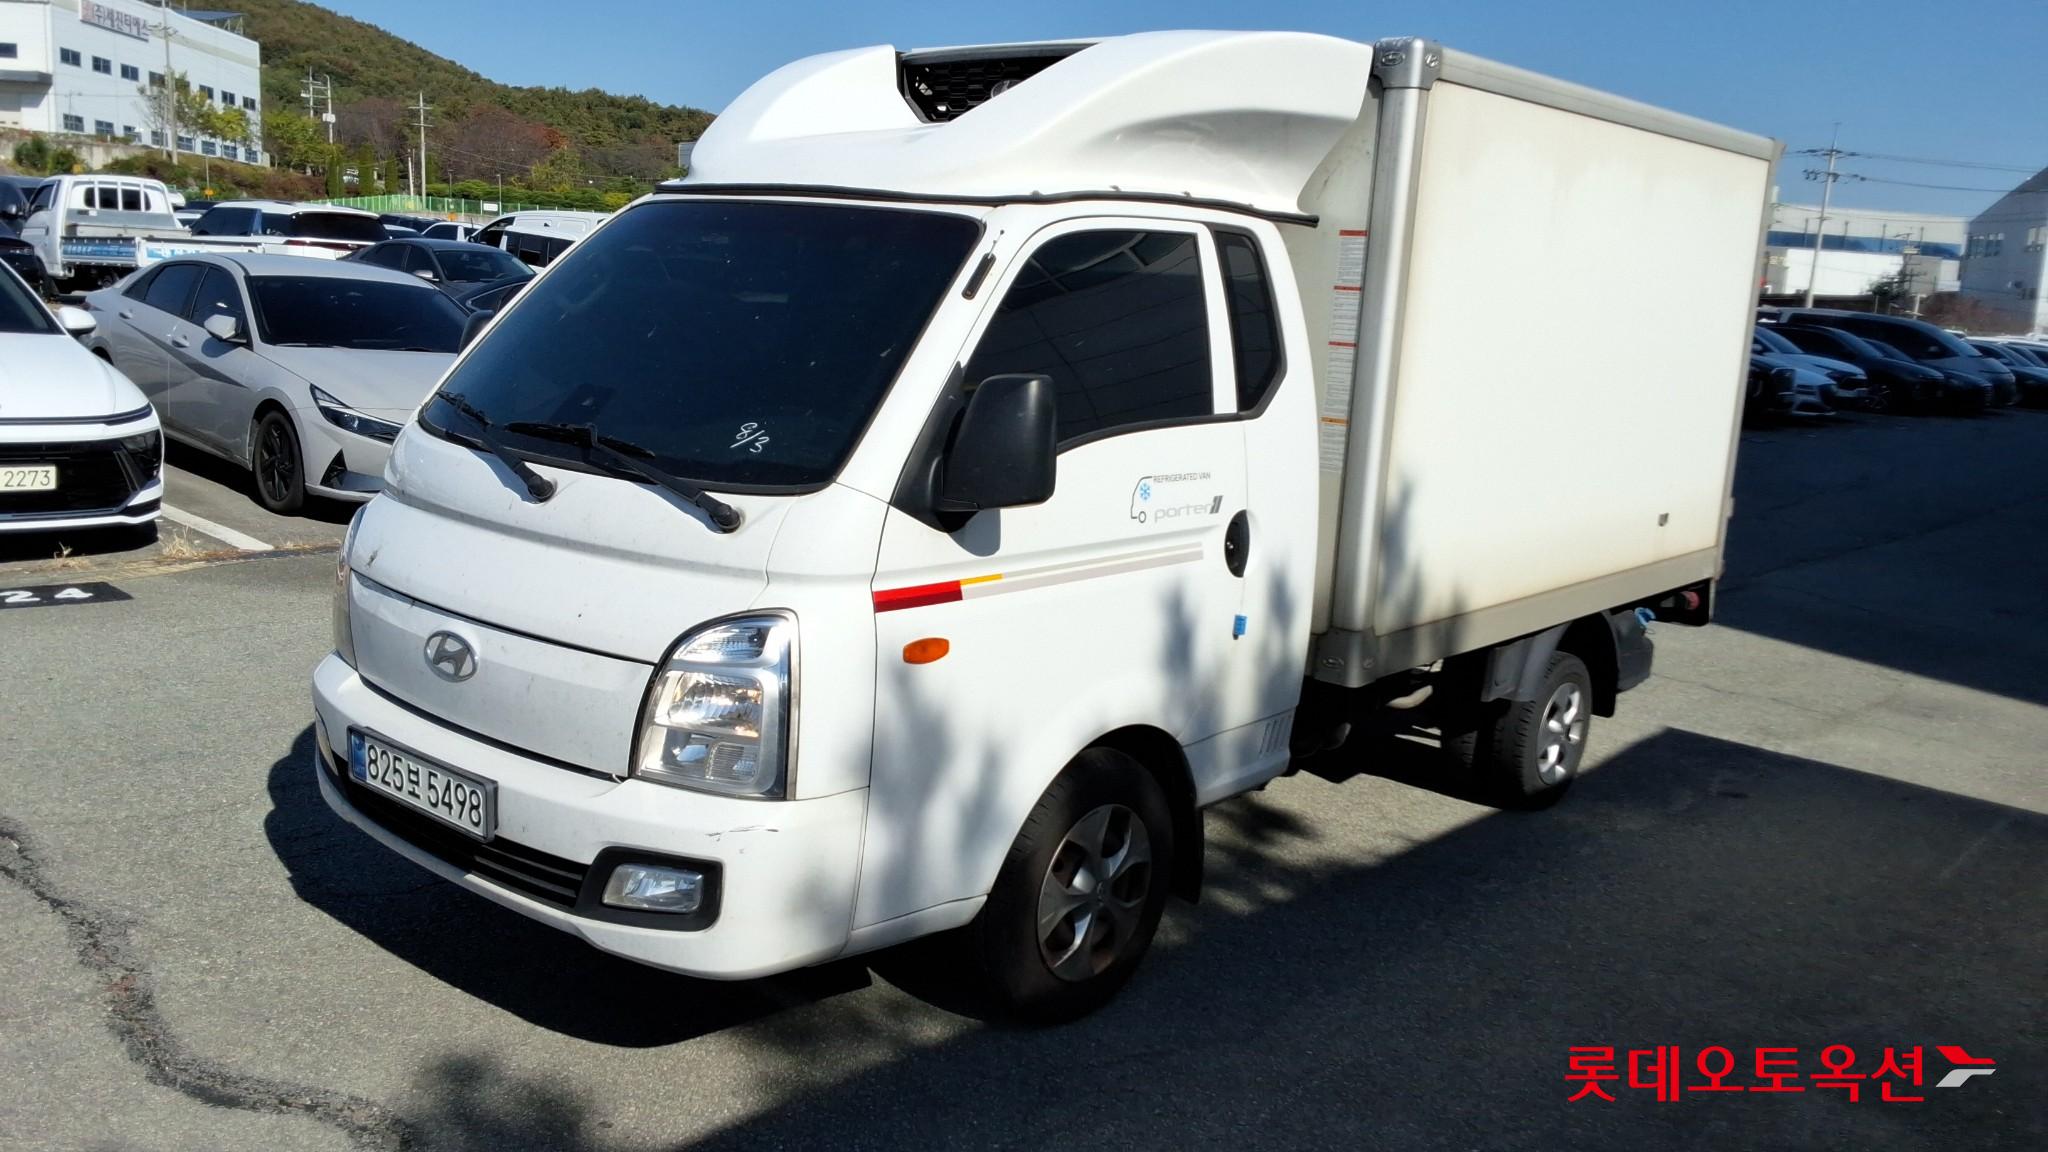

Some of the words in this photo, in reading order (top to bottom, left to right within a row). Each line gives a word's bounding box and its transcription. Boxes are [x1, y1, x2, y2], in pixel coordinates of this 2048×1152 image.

[729, 422, 770, 453] 8/3
[4, 470, 51, 488] 2273
[1152, 472, 1198, 484] REFRIGERATED
[1199, 471, 1211, 481] VAN
